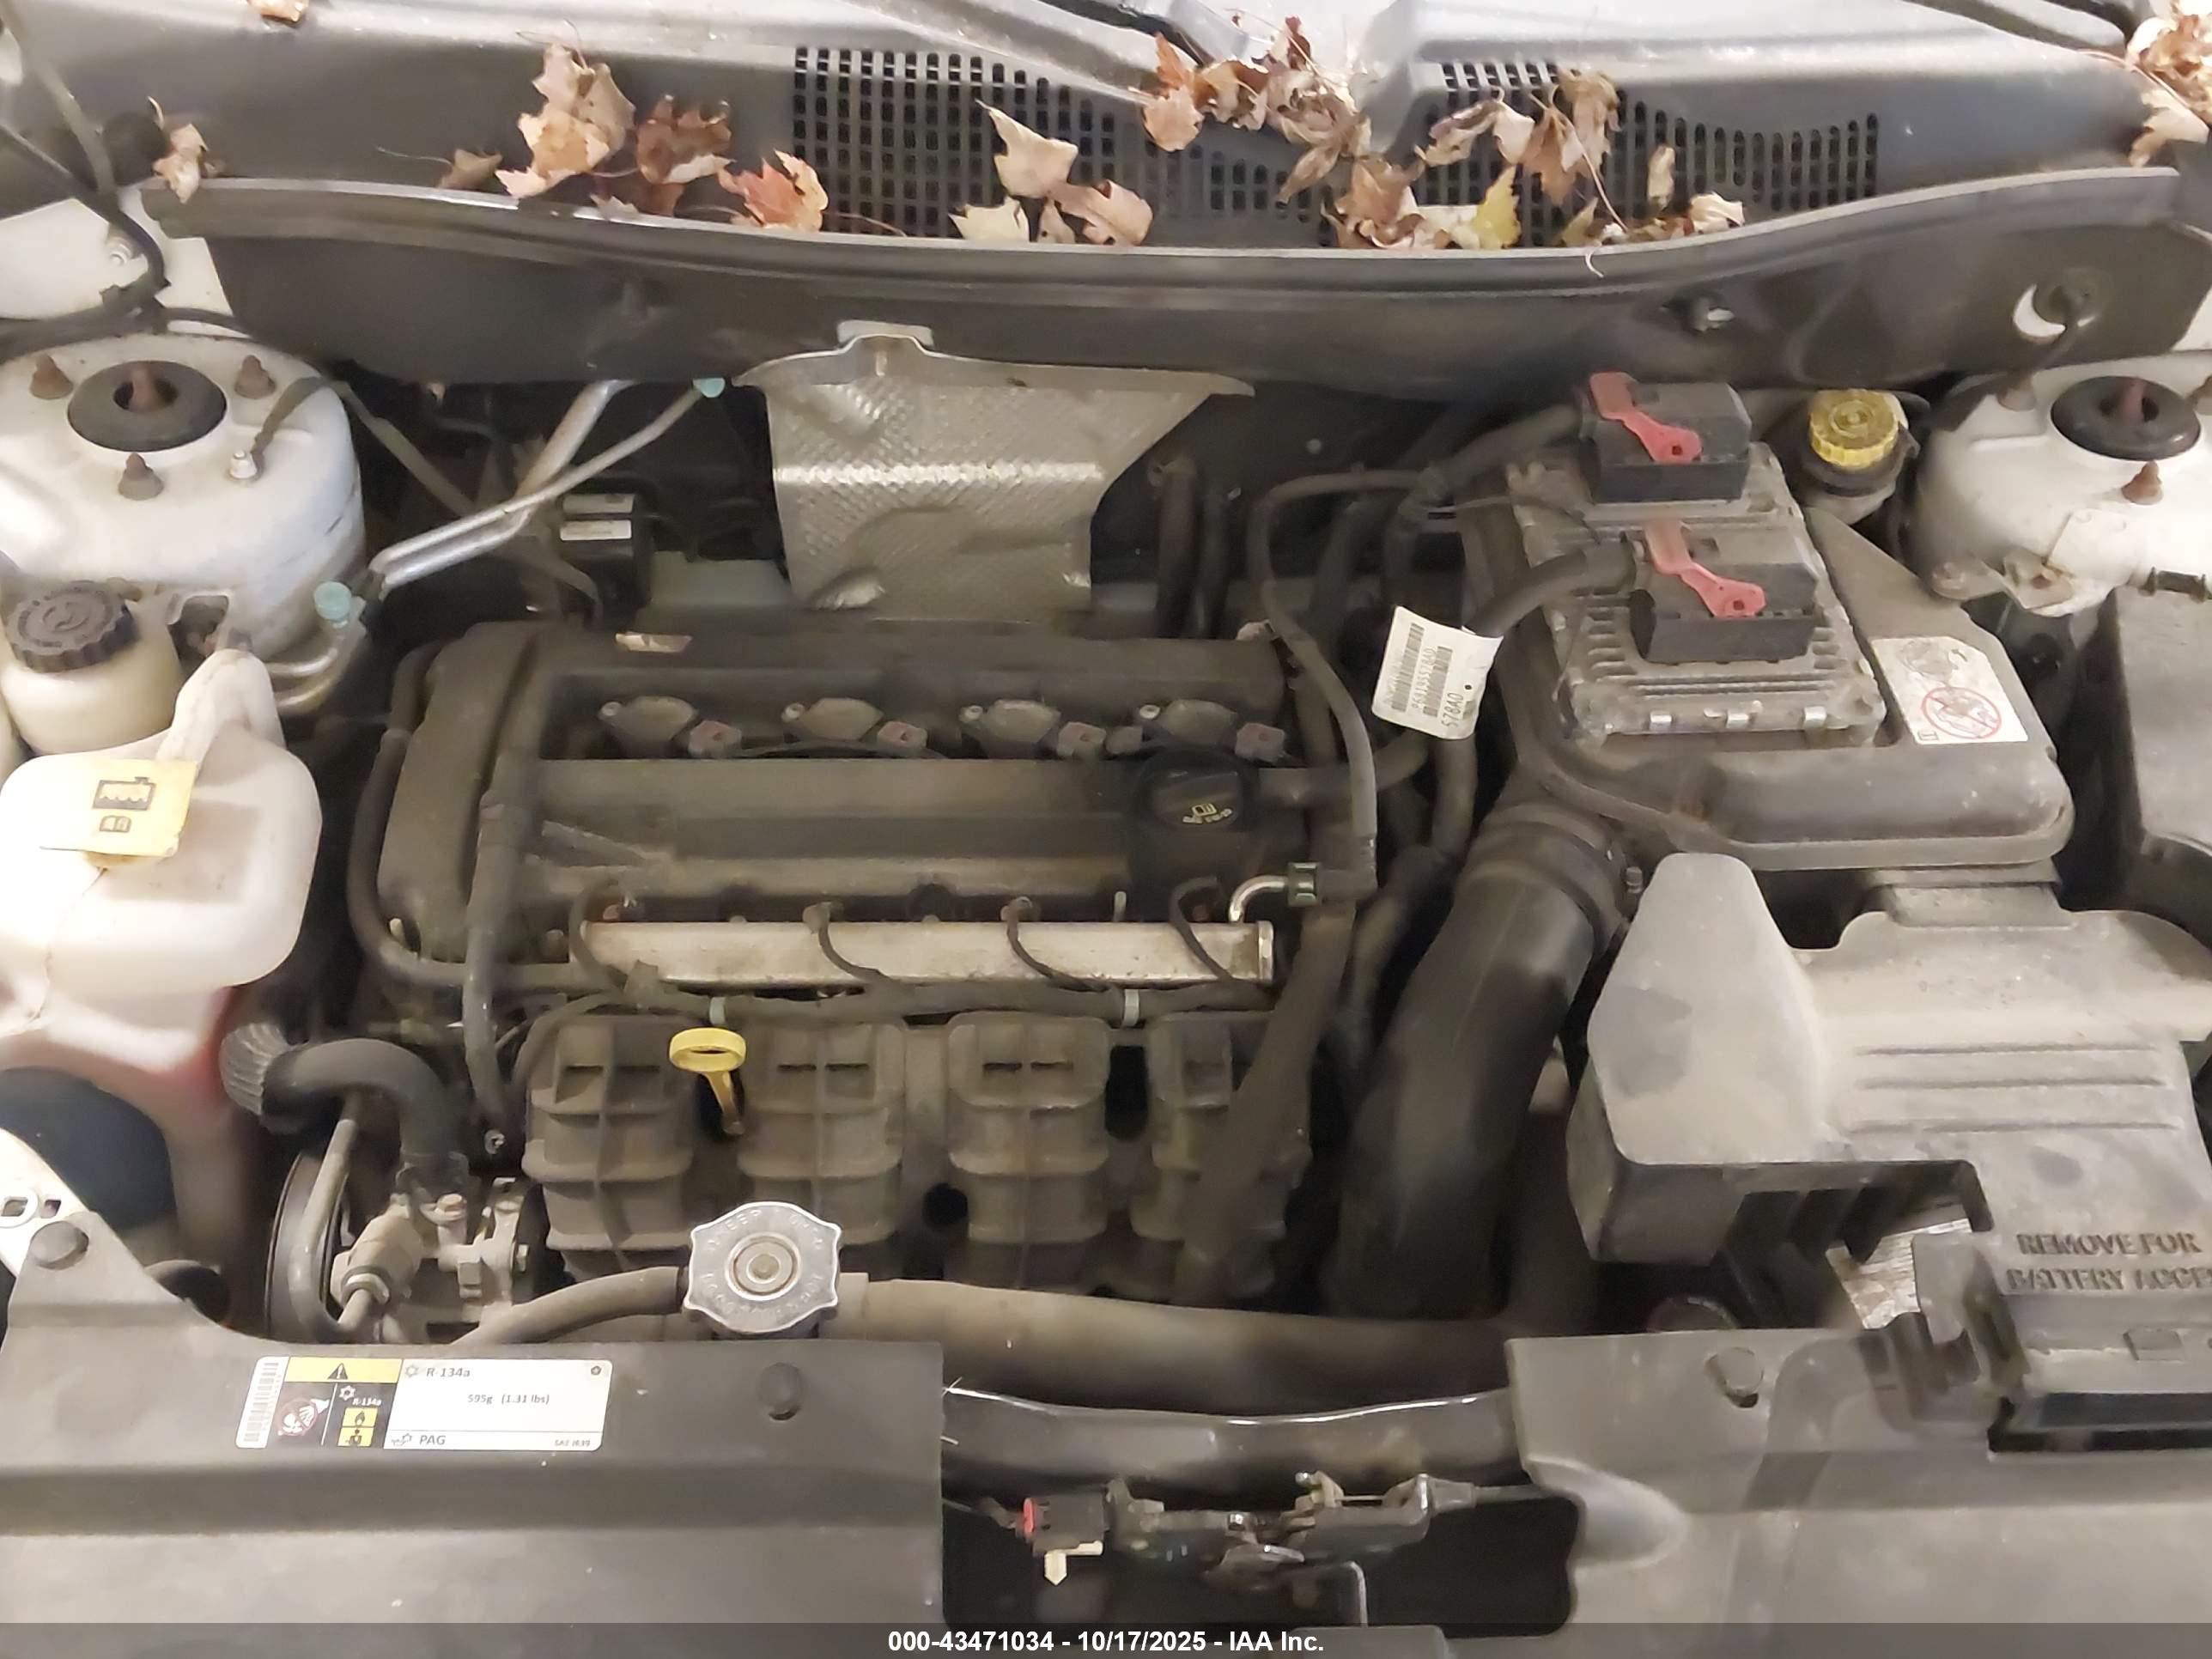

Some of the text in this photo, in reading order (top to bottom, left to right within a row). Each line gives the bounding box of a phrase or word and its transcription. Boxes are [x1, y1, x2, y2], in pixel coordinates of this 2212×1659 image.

[2015, 1231, 2203, 1255] REMOVE FOR
[2006, 1267, 2124, 1290] BATTERY
[467, 1394, 550, 1406] 595g (1.31 lbs)
[419, 1434, 447, 1446] PAG
